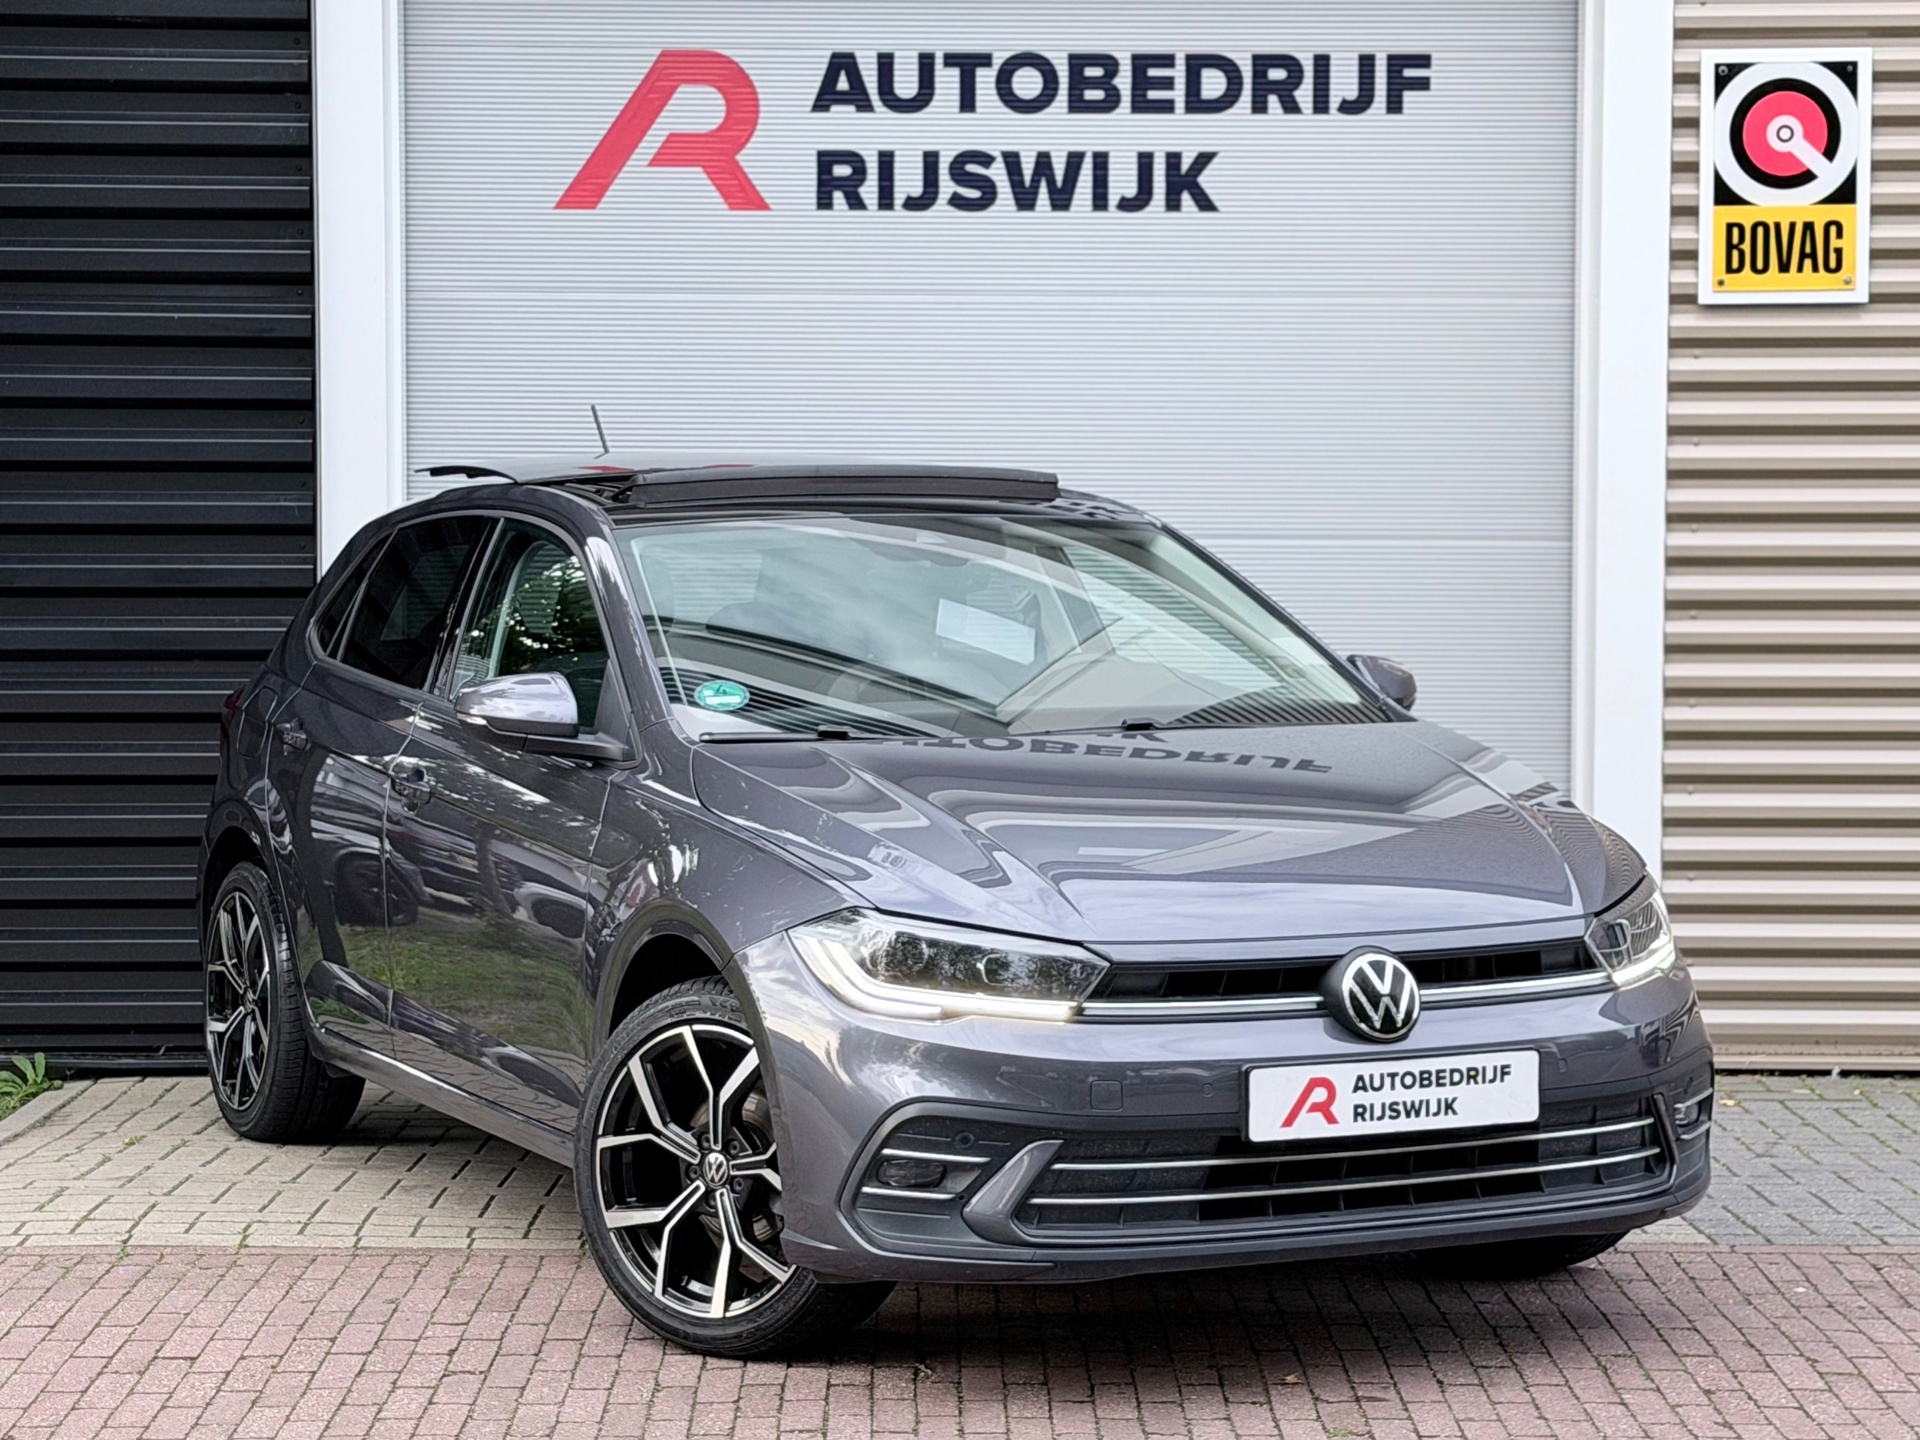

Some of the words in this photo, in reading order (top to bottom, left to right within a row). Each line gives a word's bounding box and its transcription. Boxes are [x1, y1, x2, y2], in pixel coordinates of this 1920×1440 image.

[811, 52, 1432, 115] AUTOBEDRIJF
[816, 150, 1219, 212] RIJSWIJK
[1725, 220, 1844, 275] BOVAG
[1352, 1063, 1512, 1094] AUTOBEDRIJF
[1352, 1097, 1459, 1123] RIJSWIJK
